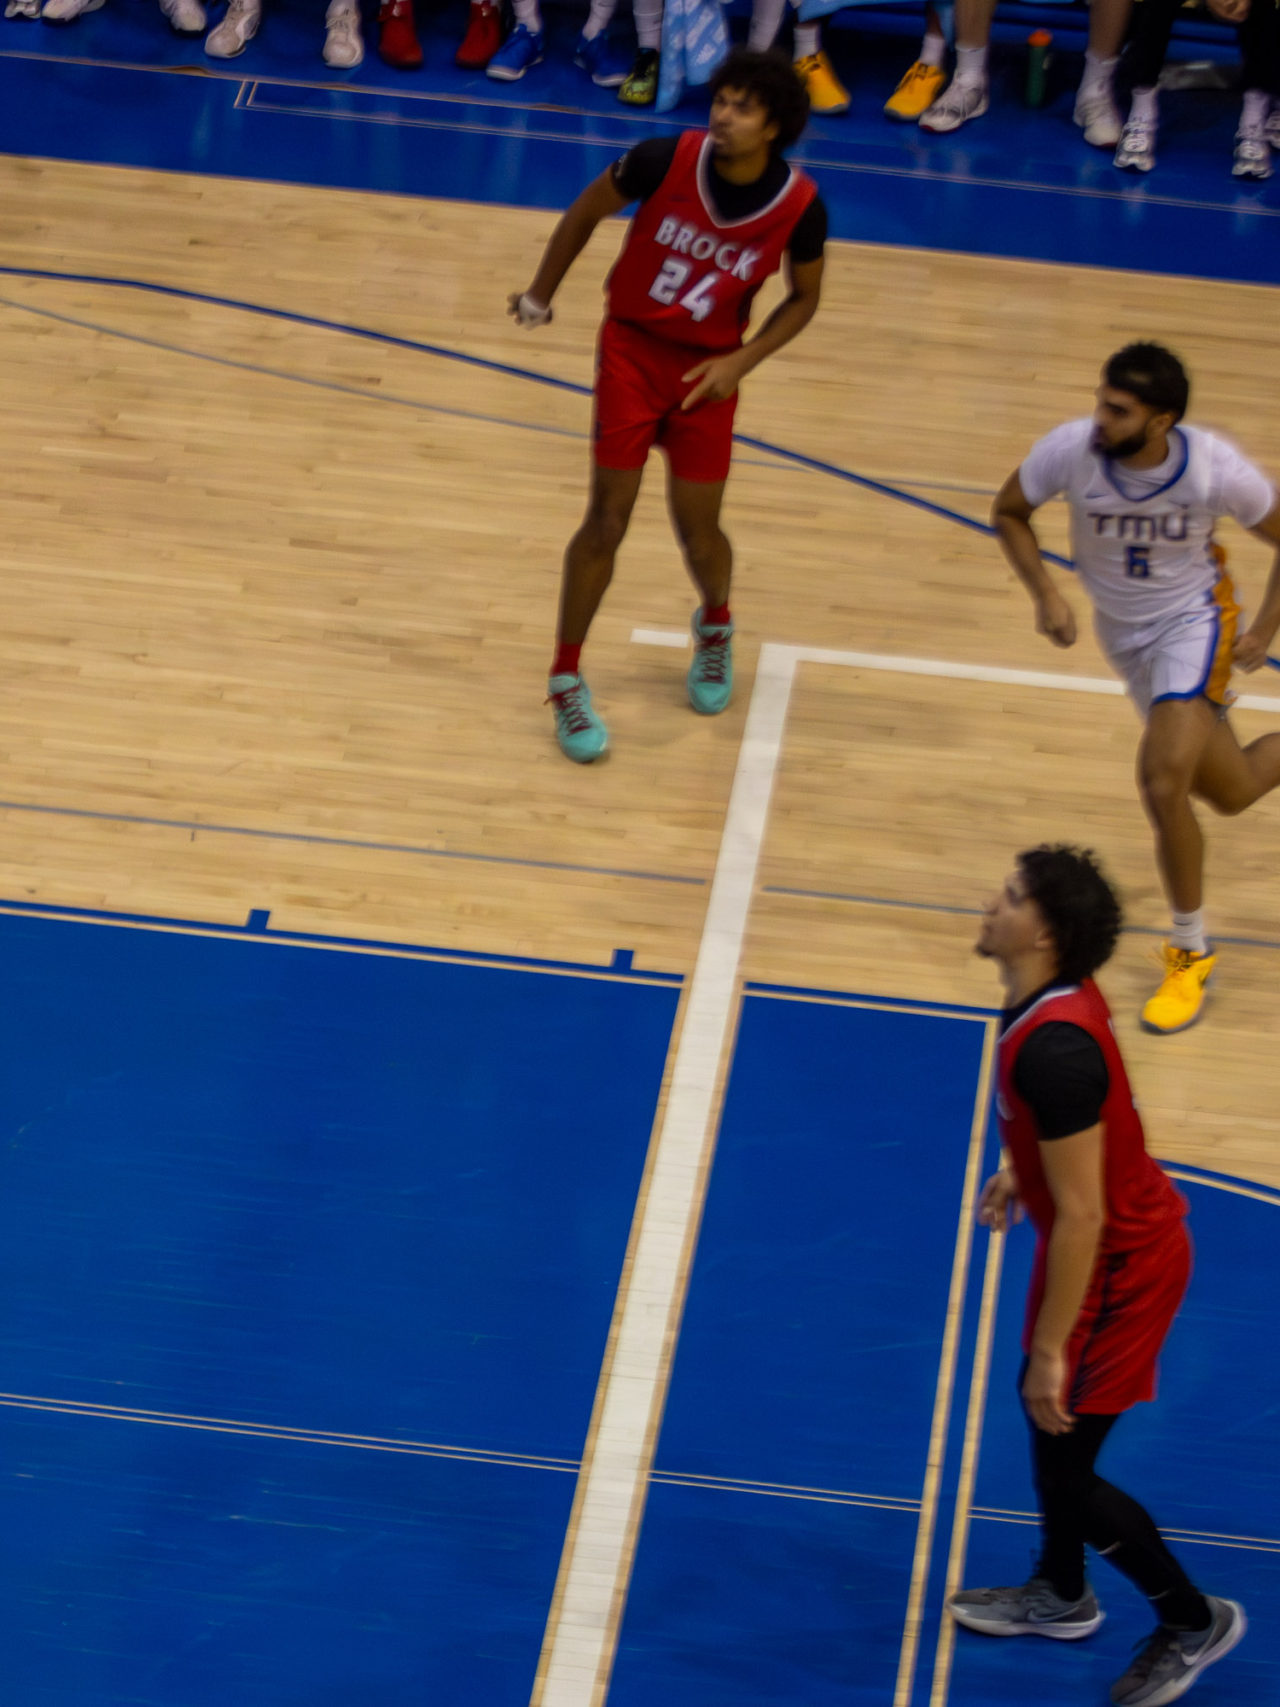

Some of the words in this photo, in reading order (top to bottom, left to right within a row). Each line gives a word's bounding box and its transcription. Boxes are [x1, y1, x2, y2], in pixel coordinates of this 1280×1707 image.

[653, 213, 761, 282] BROCK
[648, 256, 720, 323] 24
[1087, 512, 1188, 541] TMU
[1125, 545, 1151, 579] 6
